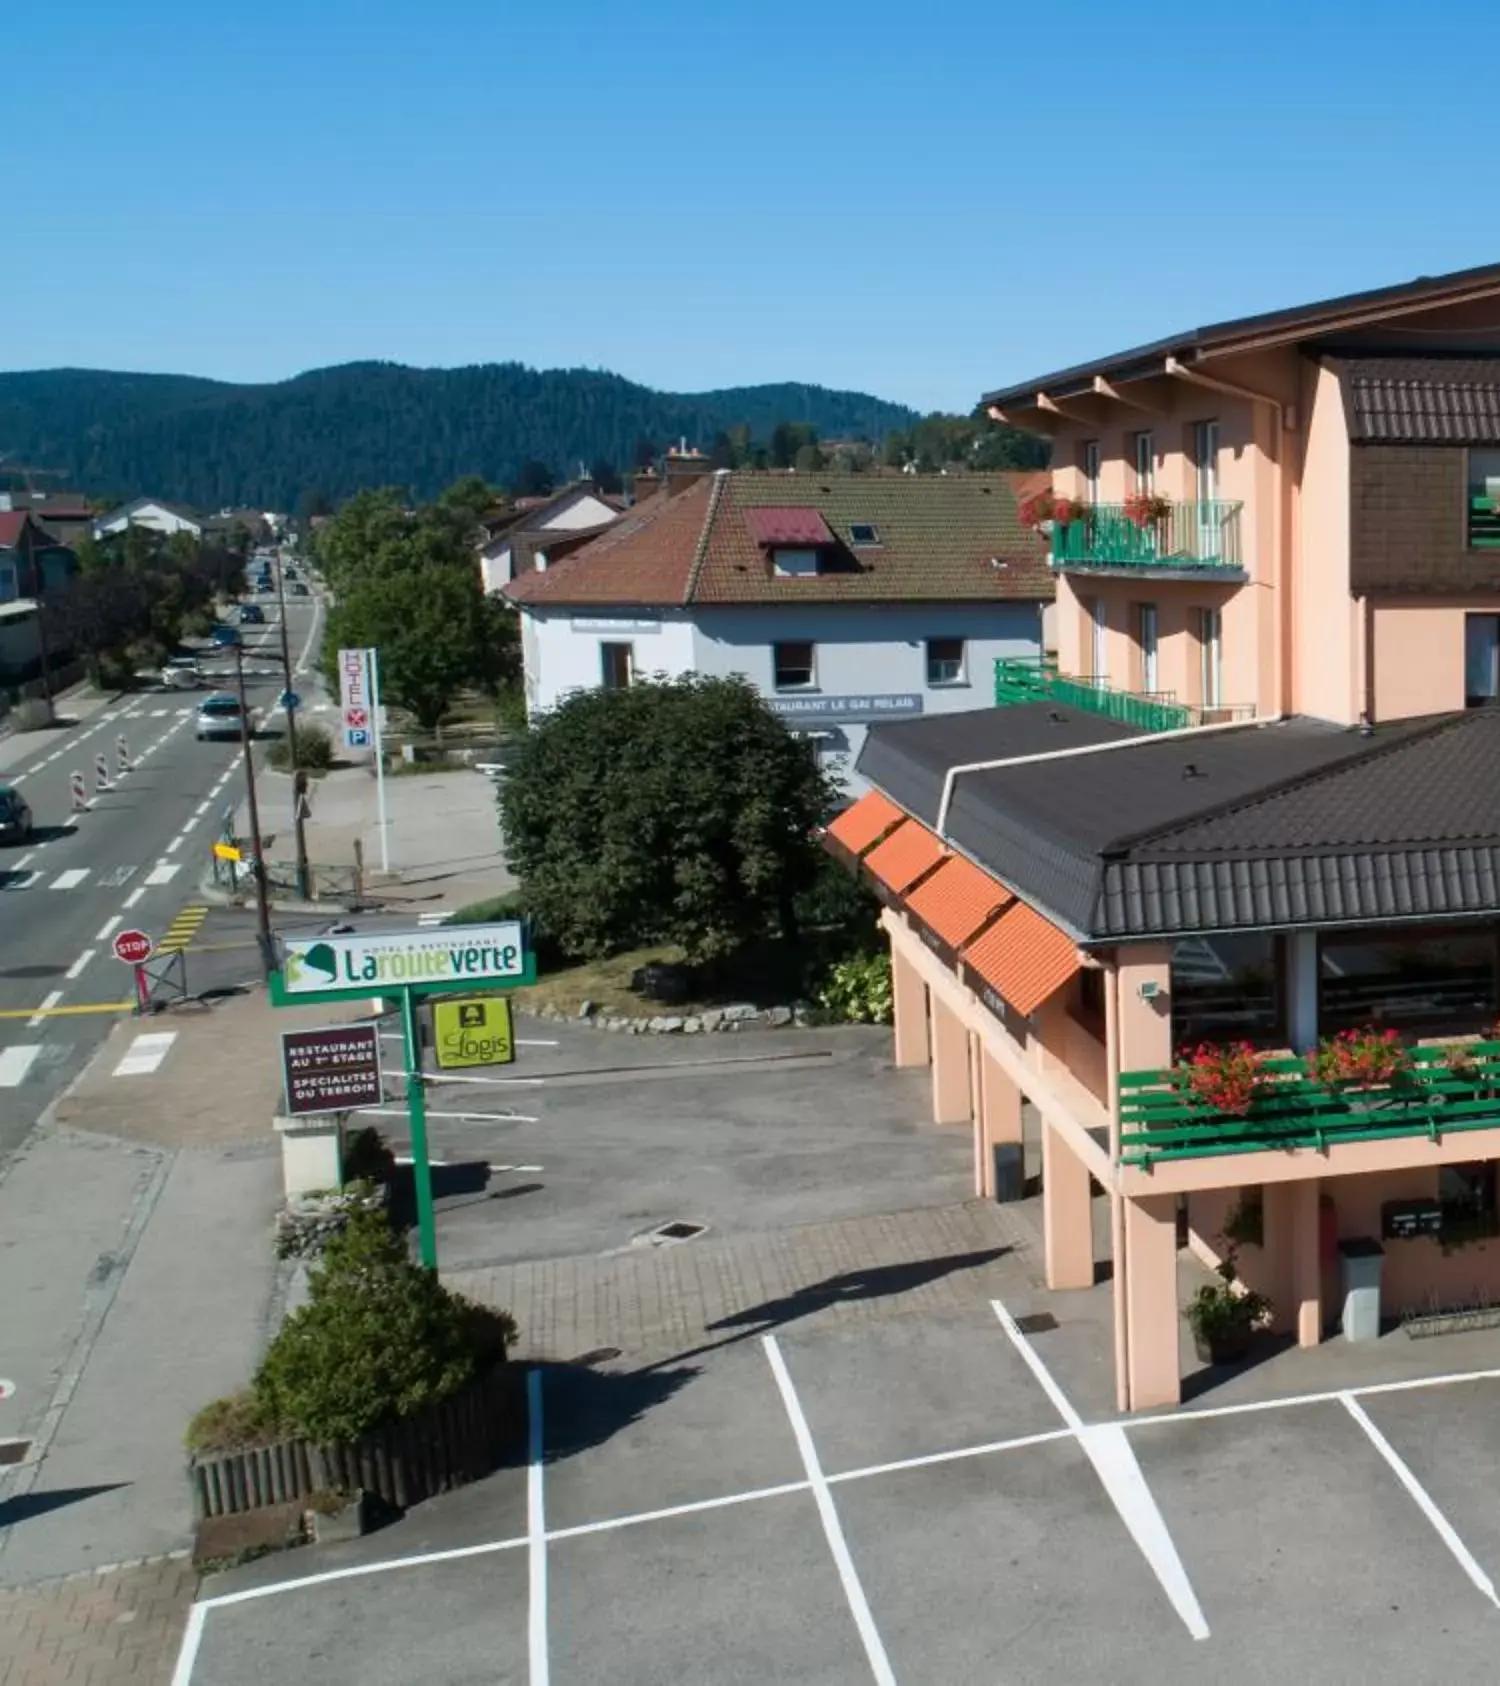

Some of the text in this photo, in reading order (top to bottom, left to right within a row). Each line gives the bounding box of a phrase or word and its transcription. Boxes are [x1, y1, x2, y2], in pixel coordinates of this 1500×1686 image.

[344, 651, 362, 705] HOTEL
[118, 940, 149, 954] STOP
[289, 1040, 373, 1056] RESTAURANT
[443, 1031, 508, 1061] Logis
